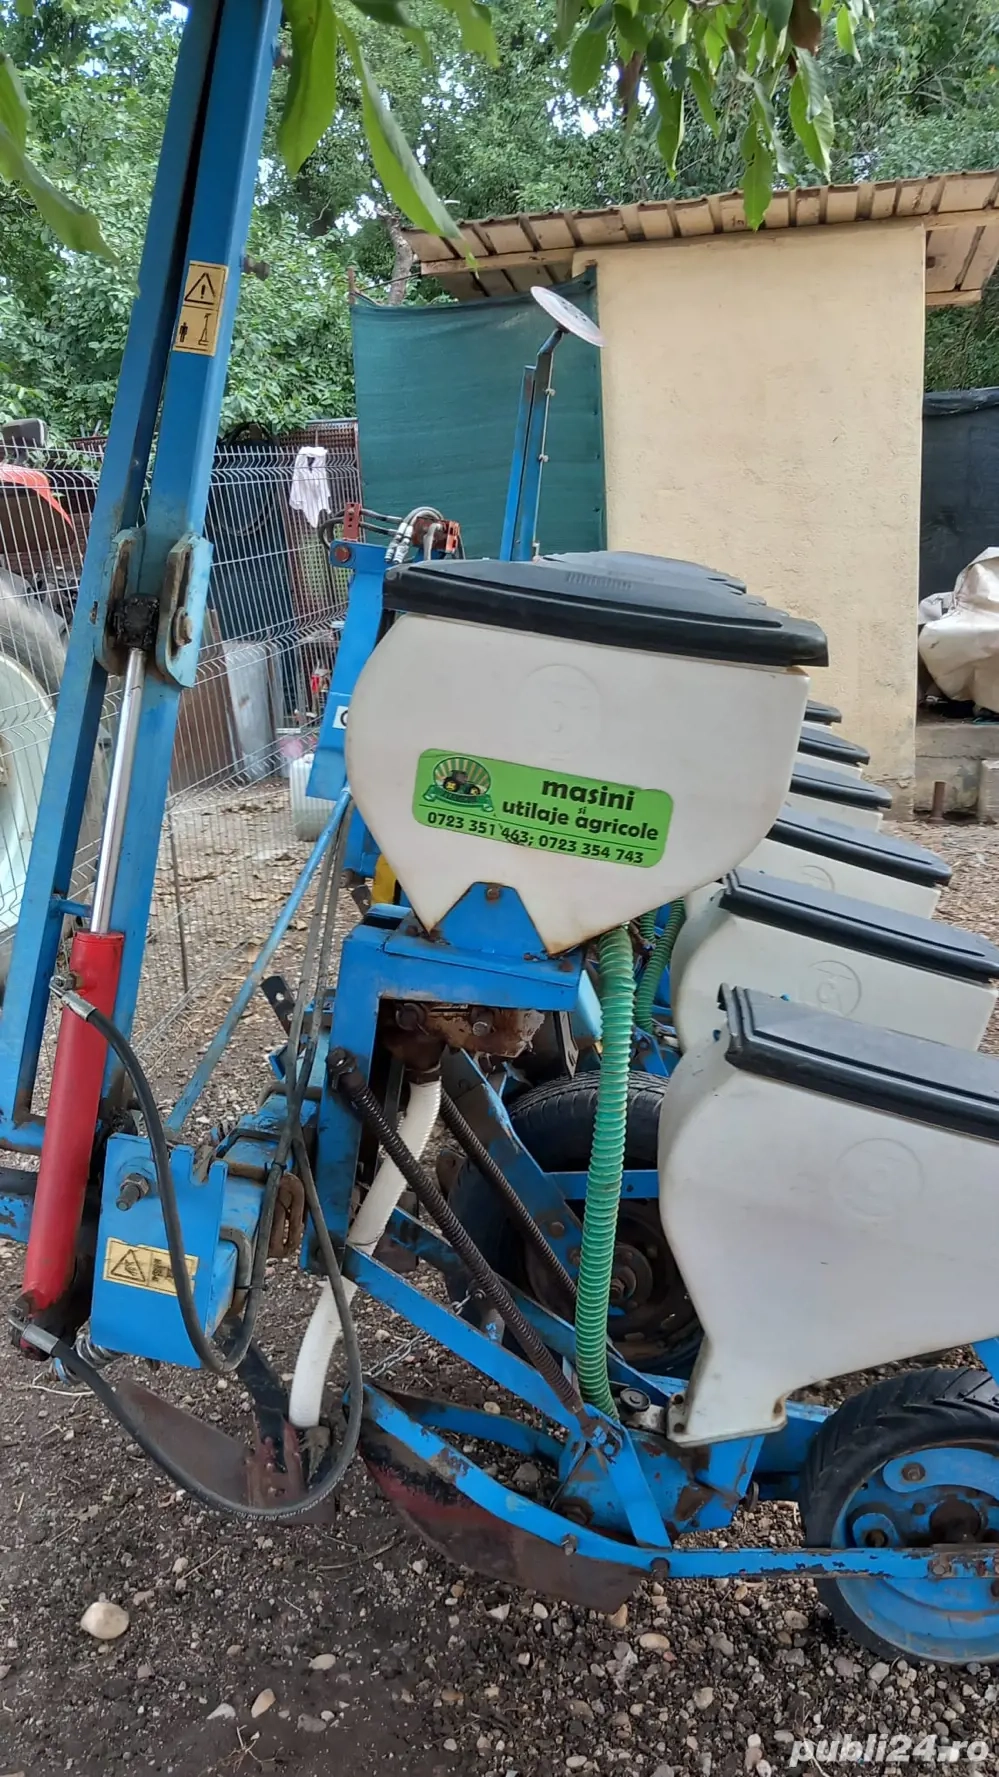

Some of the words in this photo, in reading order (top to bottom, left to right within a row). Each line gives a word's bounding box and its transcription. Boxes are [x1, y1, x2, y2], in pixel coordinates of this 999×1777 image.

[541, 779, 636, 811] masini
[427, 811, 464, 829] 0723
[468, 819, 495, 836] 351
[538, 835, 577, 853] 0723
[582, 843, 611, 859] 354
[615, 849, 644, 864] 743
[502, 800, 569, 826] utilaje
[575, 814, 659, 841] agricole
